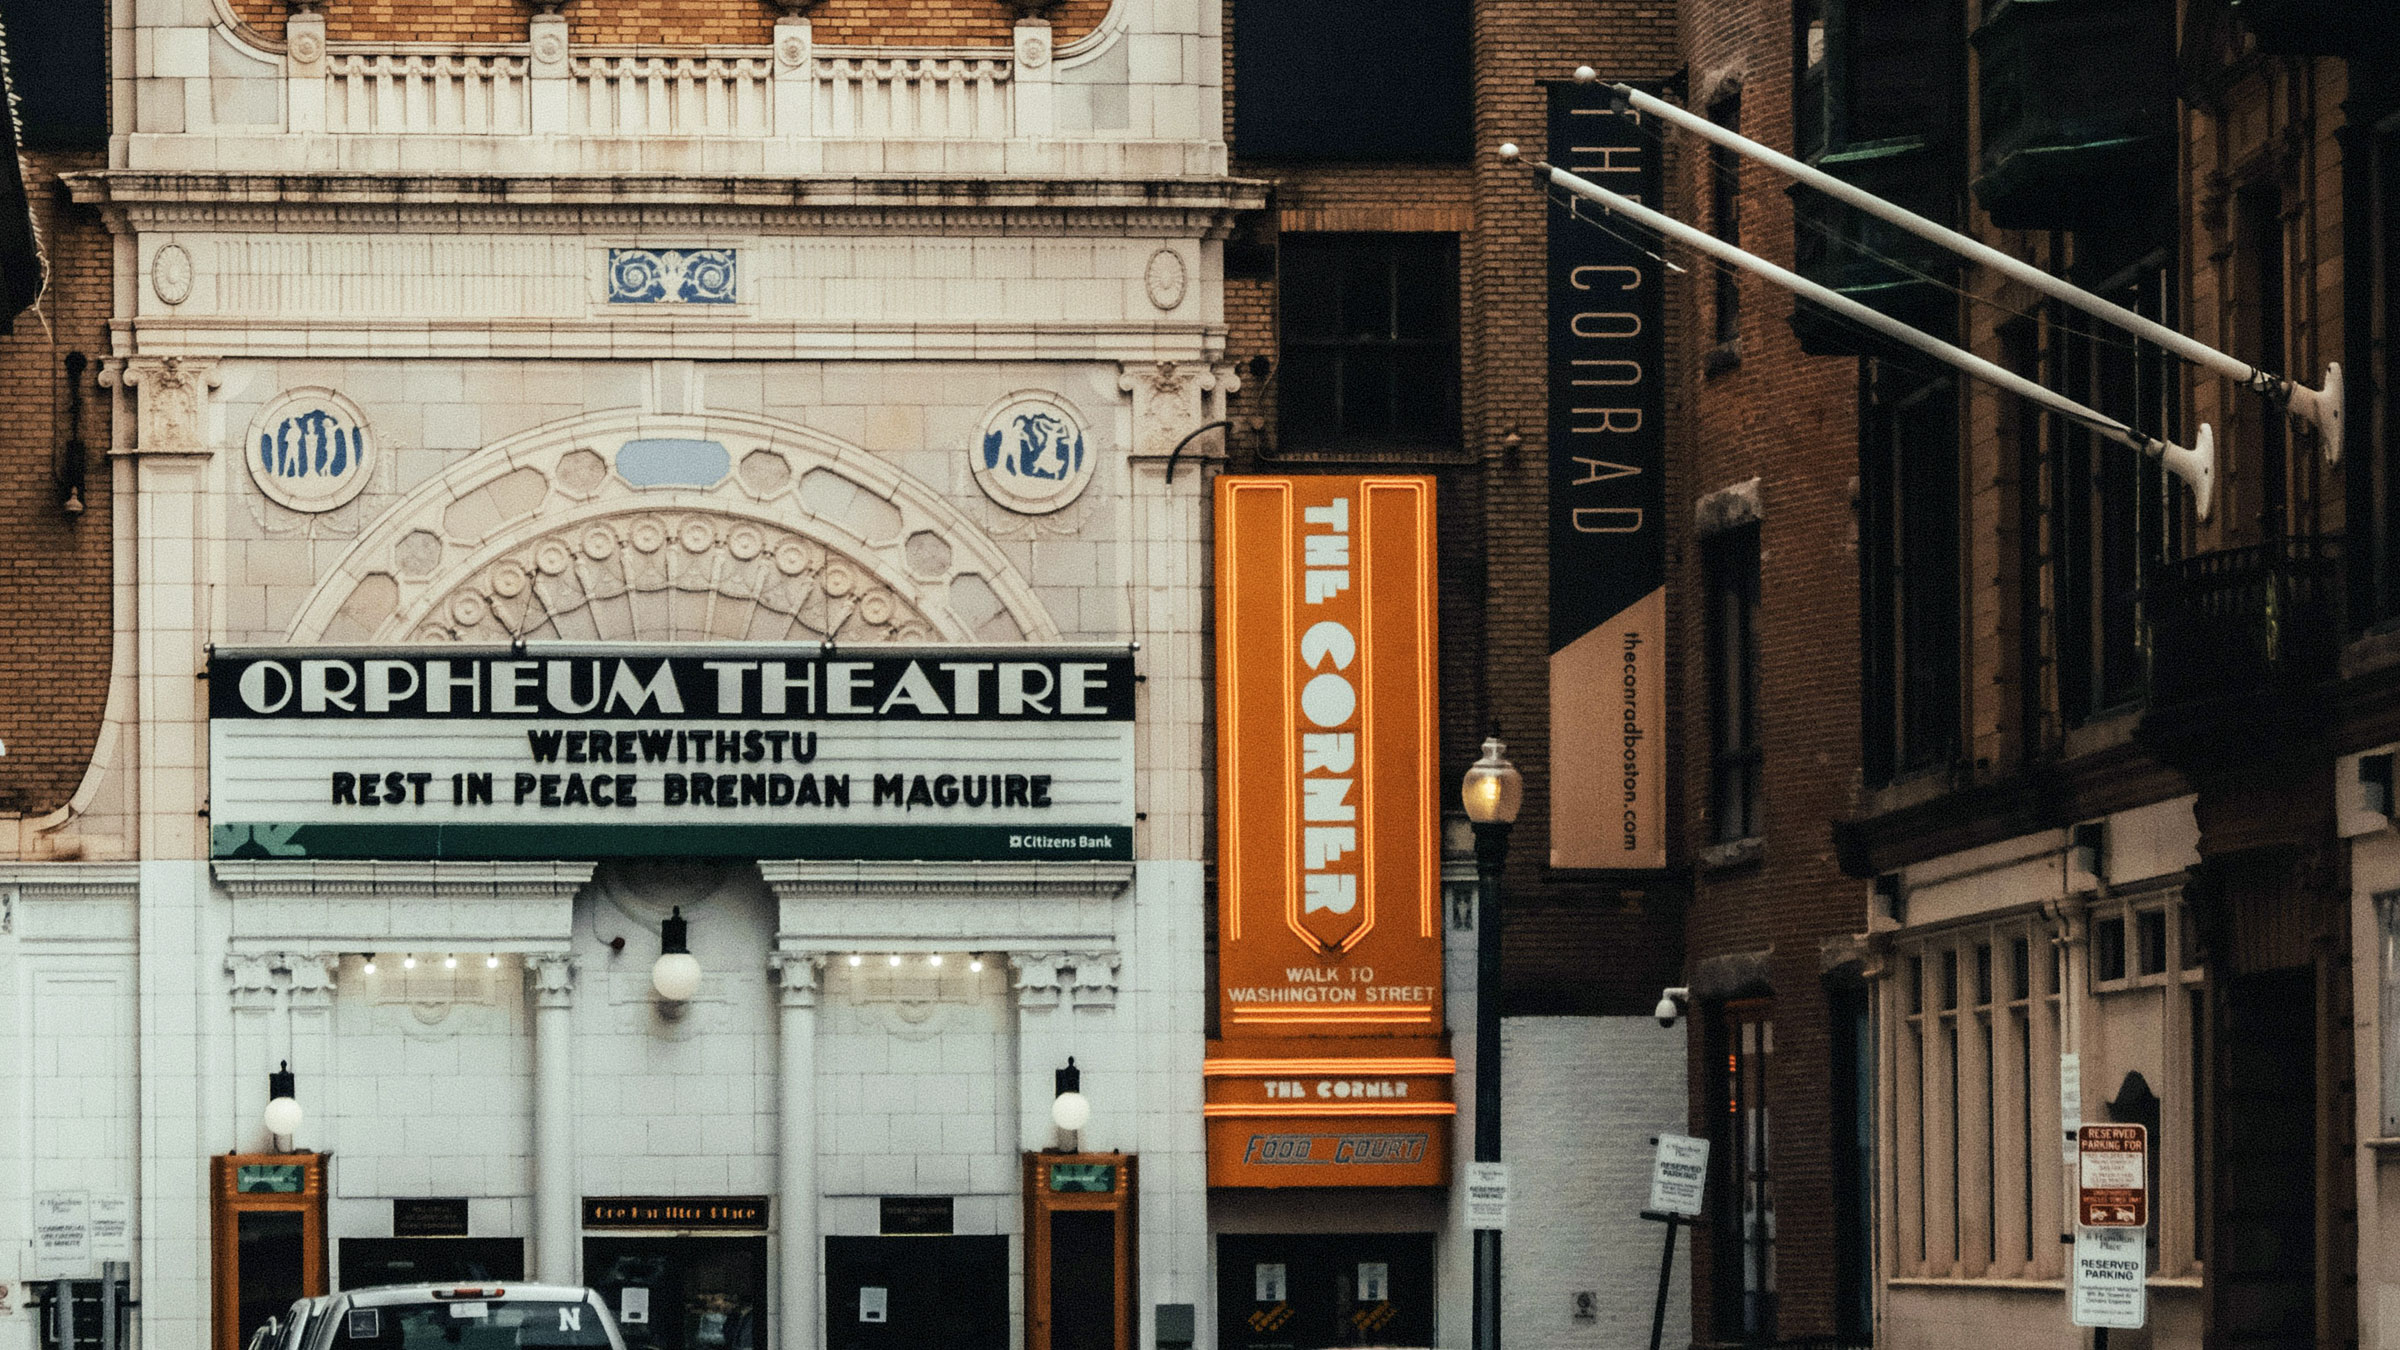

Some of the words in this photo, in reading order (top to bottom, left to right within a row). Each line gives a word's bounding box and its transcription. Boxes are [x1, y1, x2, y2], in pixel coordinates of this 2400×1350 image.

[1570, 108, 1642, 220] THE
[1570, 265, 1643, 533] CONRAD
[1304, 497, 1350, 605] THE
[238, 657, 685, 715] ORPHEUM
[702, 658, 1109, 715] THEATRE
[527, 729, 818, 764] WEREWITHSTU
[1623, 631, 1644, 851] theconradboston.com
[1300, 620, 1357, 915] CORNER
[331, 771, 433, 807] REST
[451, 772, 494, 806] IN
[513, 773, 638, 808] PEACE
[663, 772, 851, 809] BRENDAN
[872, 773, 1053, 810] MAGUIRE
[1023, 834, 1077, 849] Citizens
[1079, 834, 1113, 849] Bank
[1286, 967, 1340, 983] WALK
[1350, 966, 1375, 983] TO
[1228, 987, 1357, 1003] WASHINGTON
[1365, 986, 1436, 1002] STREET
[1264, 1080, 1306, 1098] THE
[1316, 1080, 1409, 1098] CORNER
[2088, 1128, 2136, 1139] RESERVED
[1243, 1134, 1313, 1165] FOOD
[1334, 1135, 1423, 1165] COURT
[2081, 1140, 2121, 1150] PARKING
[2124, 1140, 2142, 1150] FOR
[1661, 1162, 1702, 1174] RESERVED
[1663, 1169, 1698, 1180] PARKING
[2081, 1259, 2139, 1271] RESERVED
[2085, 1269, 2134, 1281] PARKING
[558, 1307, 582, 1331] N
